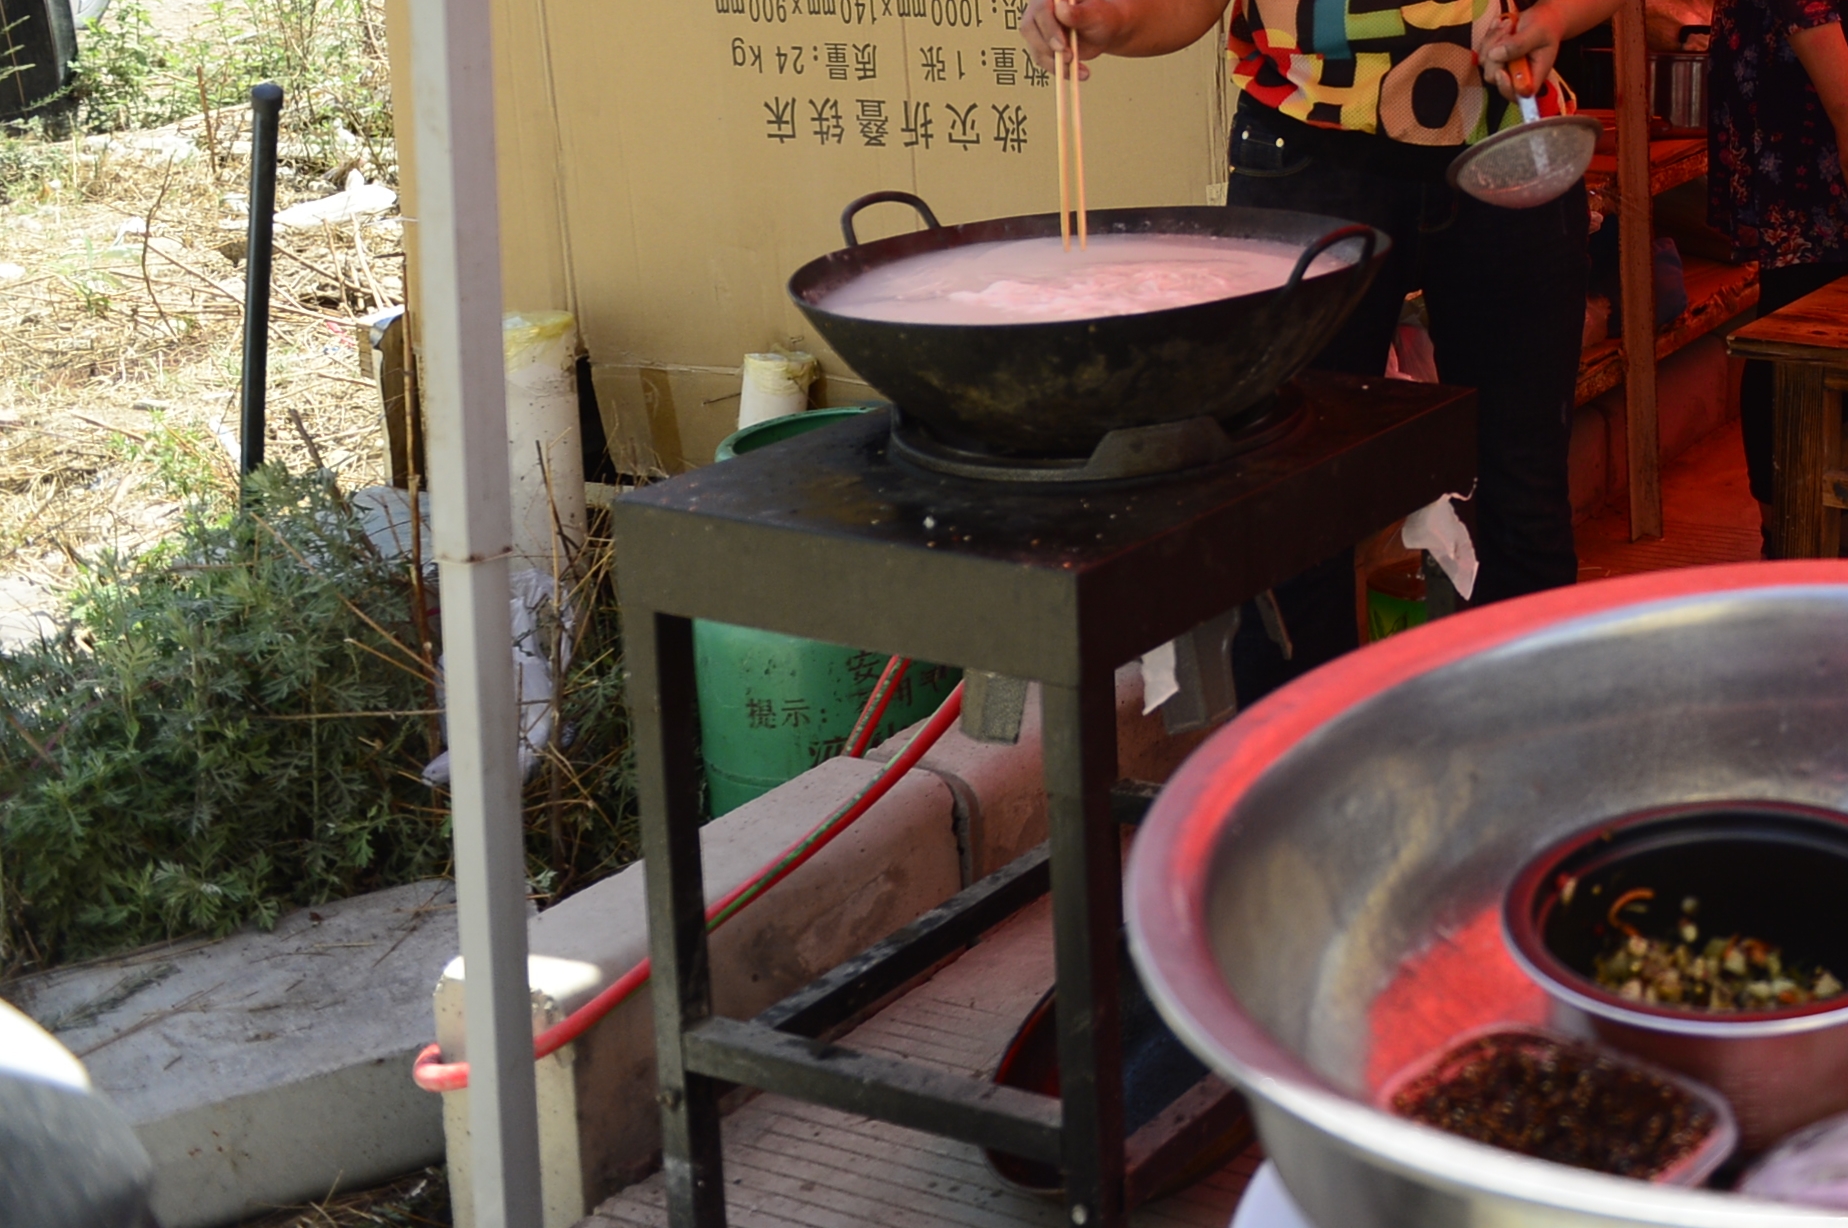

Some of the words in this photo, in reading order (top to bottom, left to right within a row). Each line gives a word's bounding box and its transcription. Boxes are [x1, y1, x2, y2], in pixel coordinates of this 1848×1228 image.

[763, 96, 1028, 154] 救灾折叠铁床
